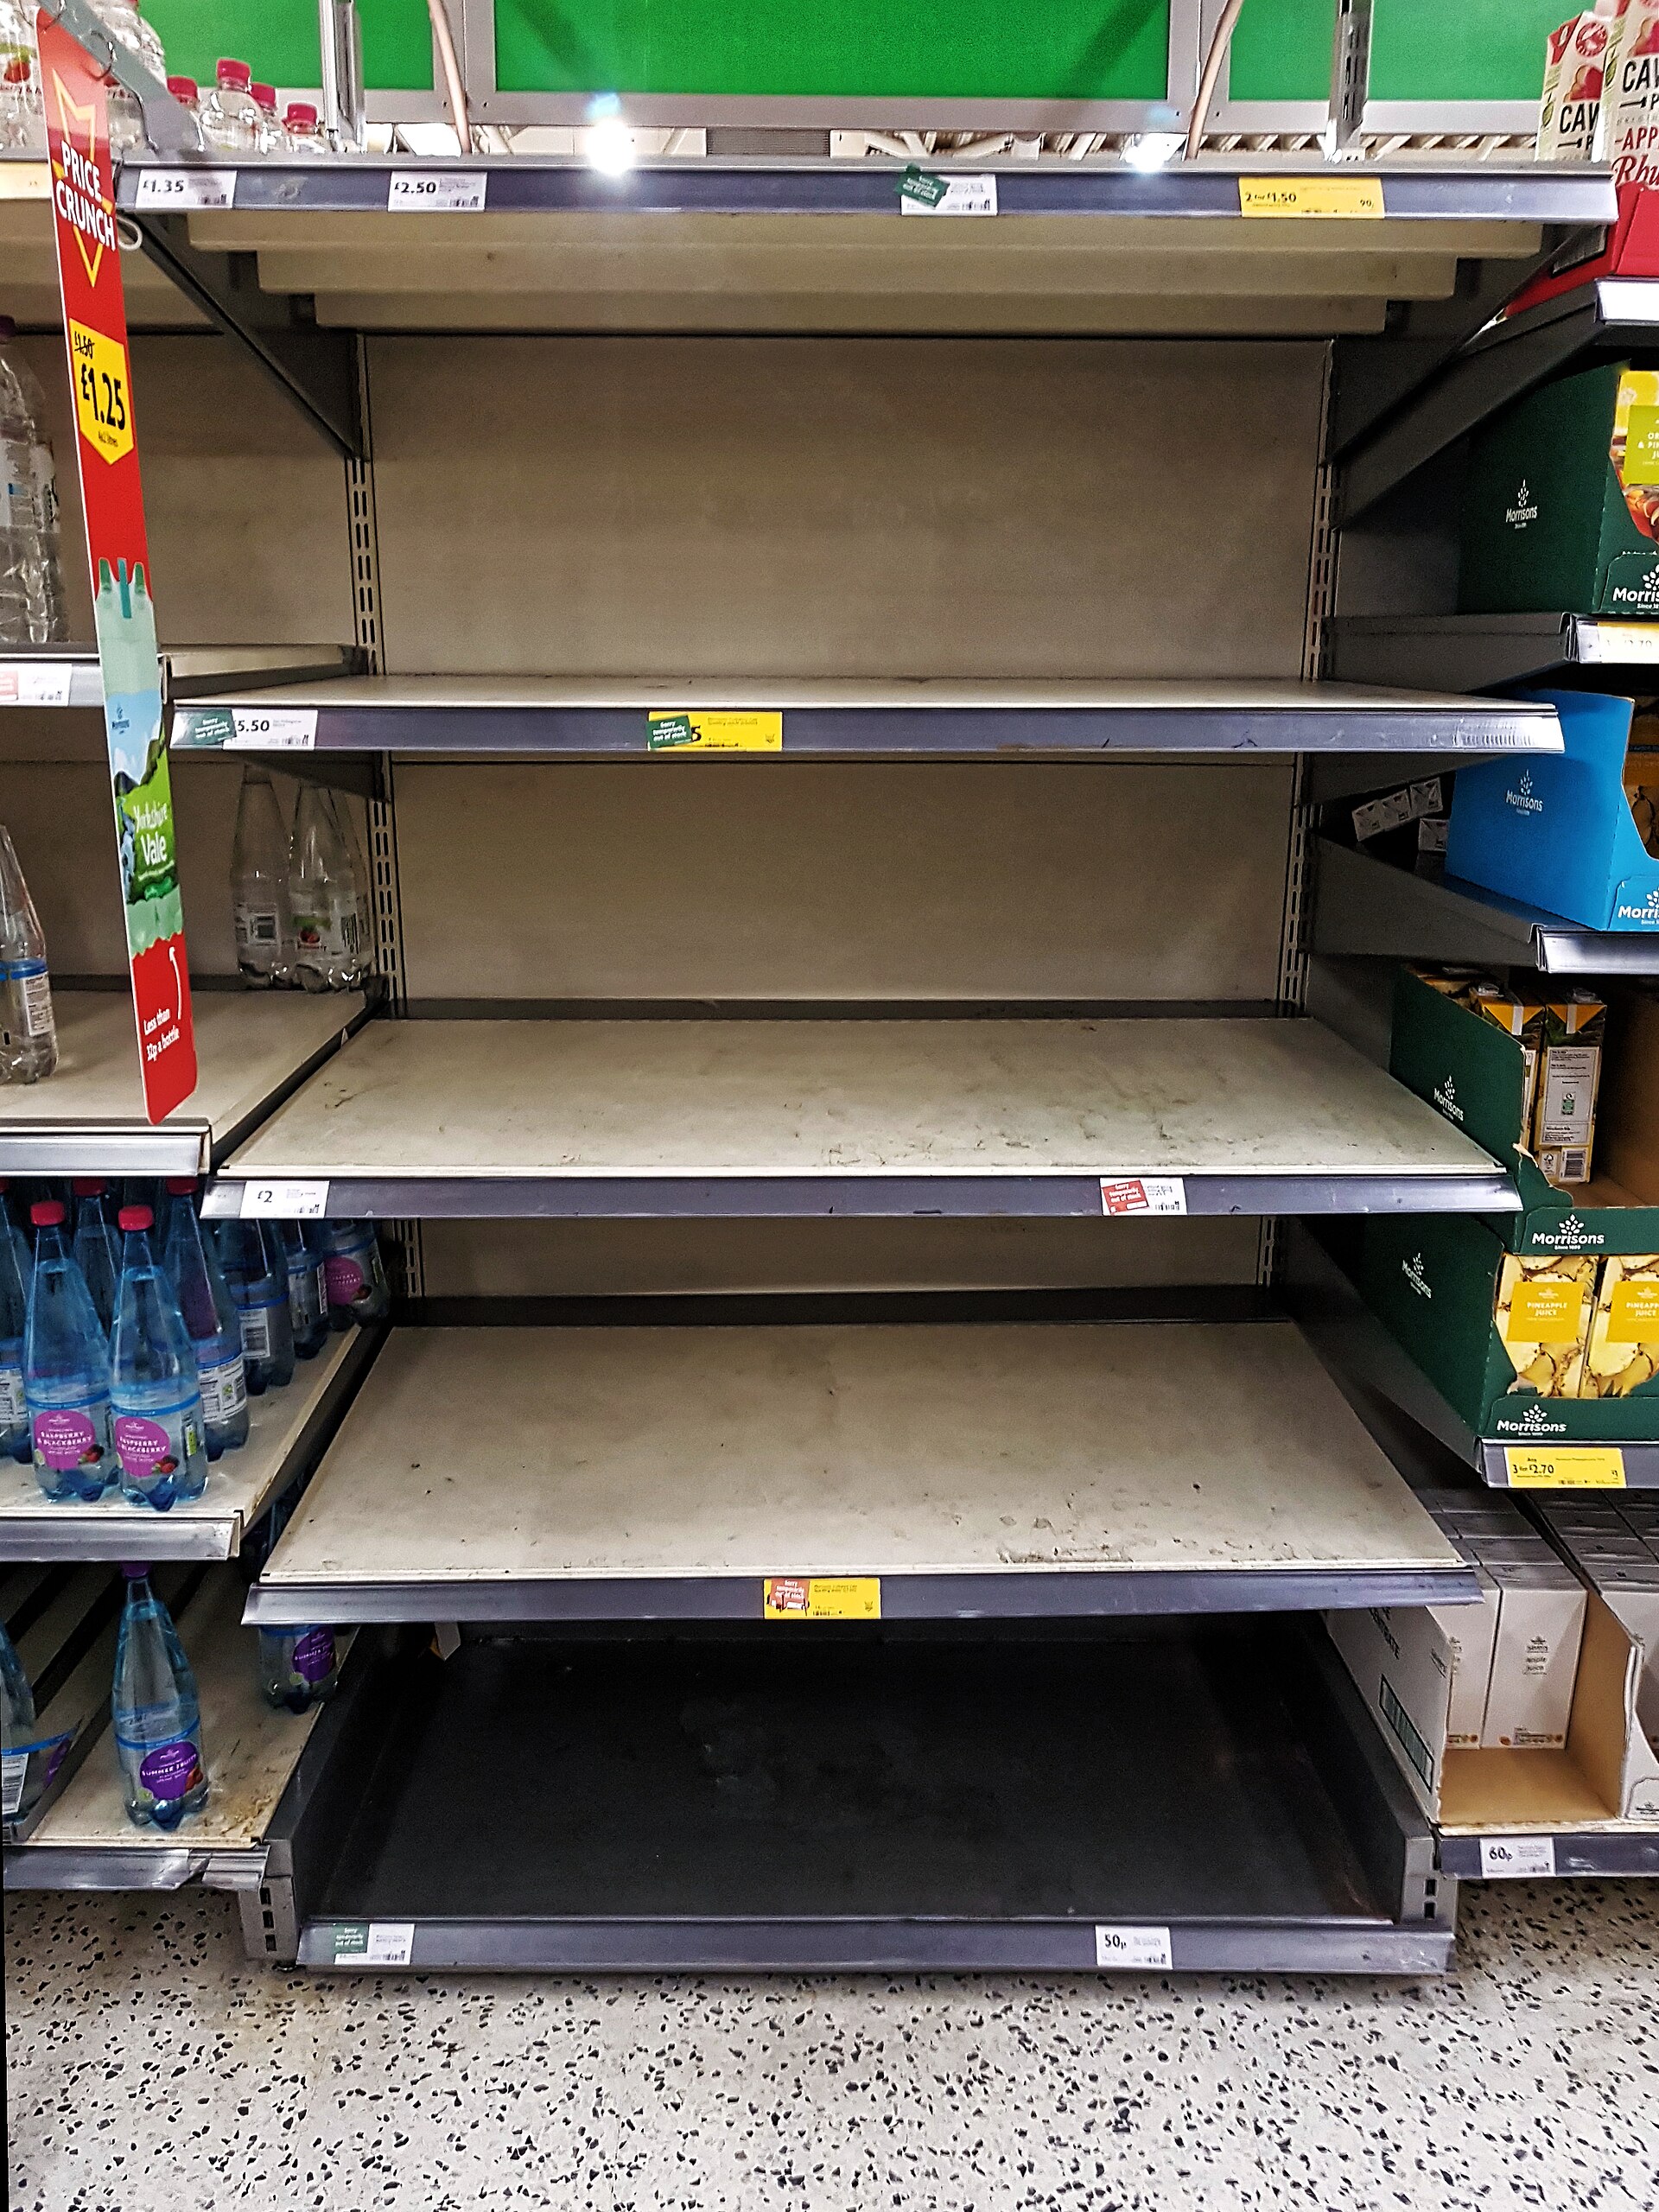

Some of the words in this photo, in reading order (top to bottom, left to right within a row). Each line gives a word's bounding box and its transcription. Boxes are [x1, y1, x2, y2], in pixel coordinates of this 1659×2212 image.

[61, 141, 103, 203] PRICE
[395, 181, 436, 194] £2.50
[1245, 191, 1252, 201] 2
[55, 180, 117, 251] CRUNCH
[81, 363, 125, 430] £1.25
[1506, 506, 1537, 523] Morrisons
[235, 720, 270, 732] 5.50
[1506, 790, 1543, 812] Morrisons
[140, 831, 168, 866] Vale
[1618, 906, 1659, 918] Morri
[257, 1191, 273, 1203] £2
[1532, 1233, 1605, 1245] Morrisons
[1497, 1420, 1567, 1432] Morrisons
[1512, 1465, 1518, 1474] 3
[1489, 1847, 1513, 1861] 60p
[1104, 1934, 1127, 1951] 50p
